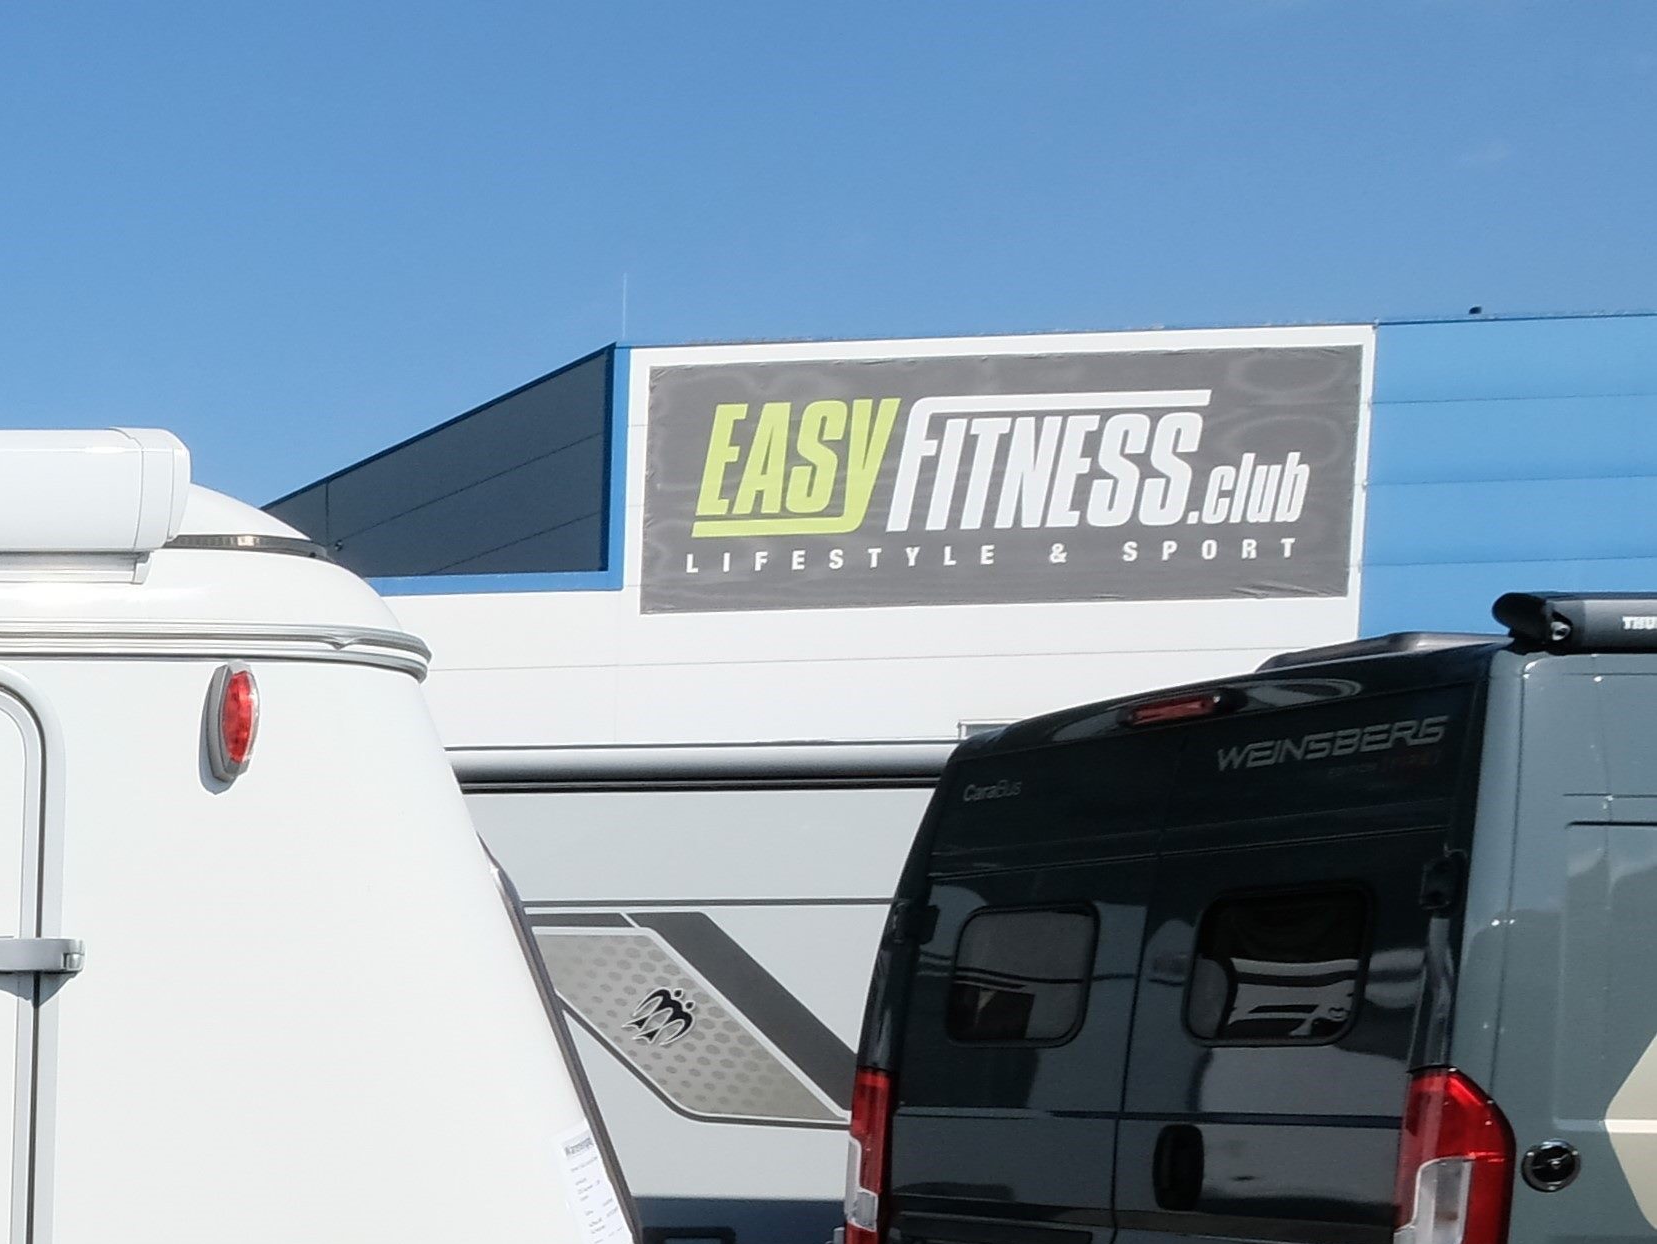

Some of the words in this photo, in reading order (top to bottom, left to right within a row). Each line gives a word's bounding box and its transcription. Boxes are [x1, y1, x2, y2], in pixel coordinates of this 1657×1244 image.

[686, 543, 995, 574] LIFESTYLE
[1049, 543, 1068, 564] &
[1122, 537, 1296, 563] SPORT
[1216, 714, 1451, 772] WEINSBERG
